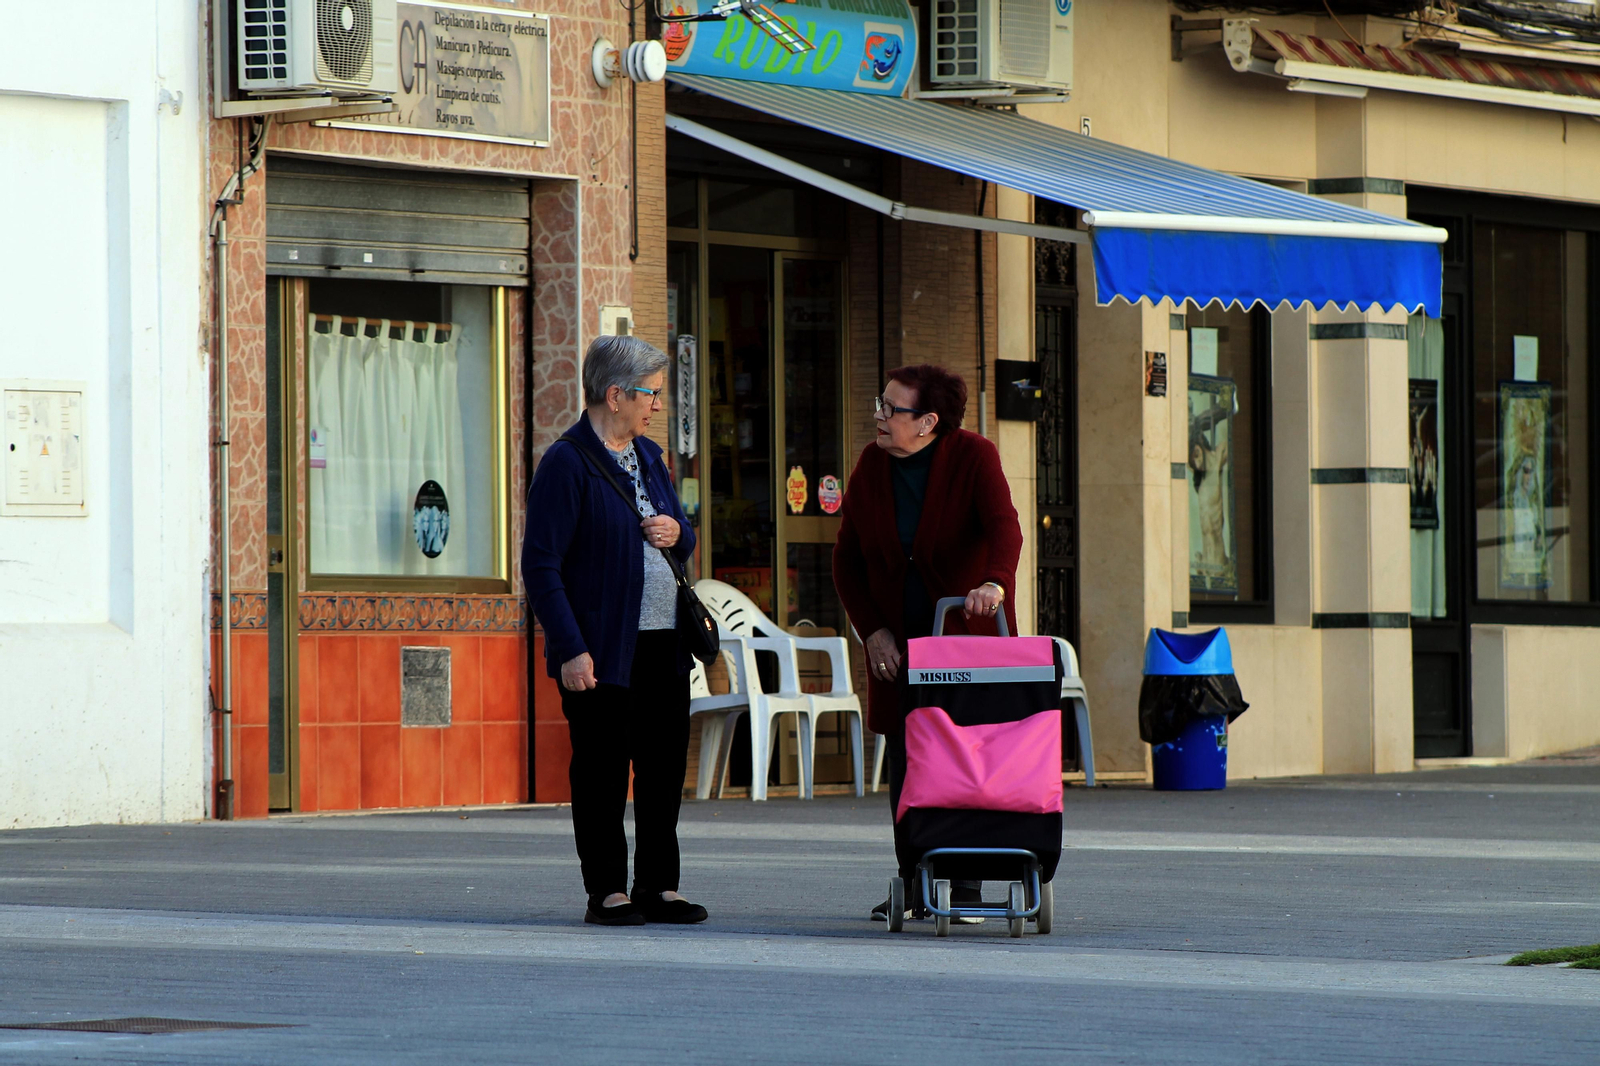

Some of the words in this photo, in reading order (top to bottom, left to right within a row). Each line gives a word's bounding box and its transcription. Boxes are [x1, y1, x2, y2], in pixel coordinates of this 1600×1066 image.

[435, 11, 474, 31] Depilación
[476, 20, 480, 30] a
[482, 16, 489, 31] la
[490, 21, 506, 33] cera
[507, 23, 512, 37] y
[435, 35, 470, 53] Manicura
[472, 43, 477, 58] y
[478, 40, 512, 57] Pedicura.
[713, 14, 843, 75] RUBIO
[436, 60, 465, 81] Masajes
[466, 65, 505, 84] corporales.
[436, 84, 469, 105] Limpieza
[470, 87, 479, 102] de
[482, 89, 501, 105] cutis.
[435, 108, 458, 128] Rayos
[460, 114, 475, 126] uva.
[1082, 118, 1090, 137] 5
[919, 671, 972, 683] MISIUSS
